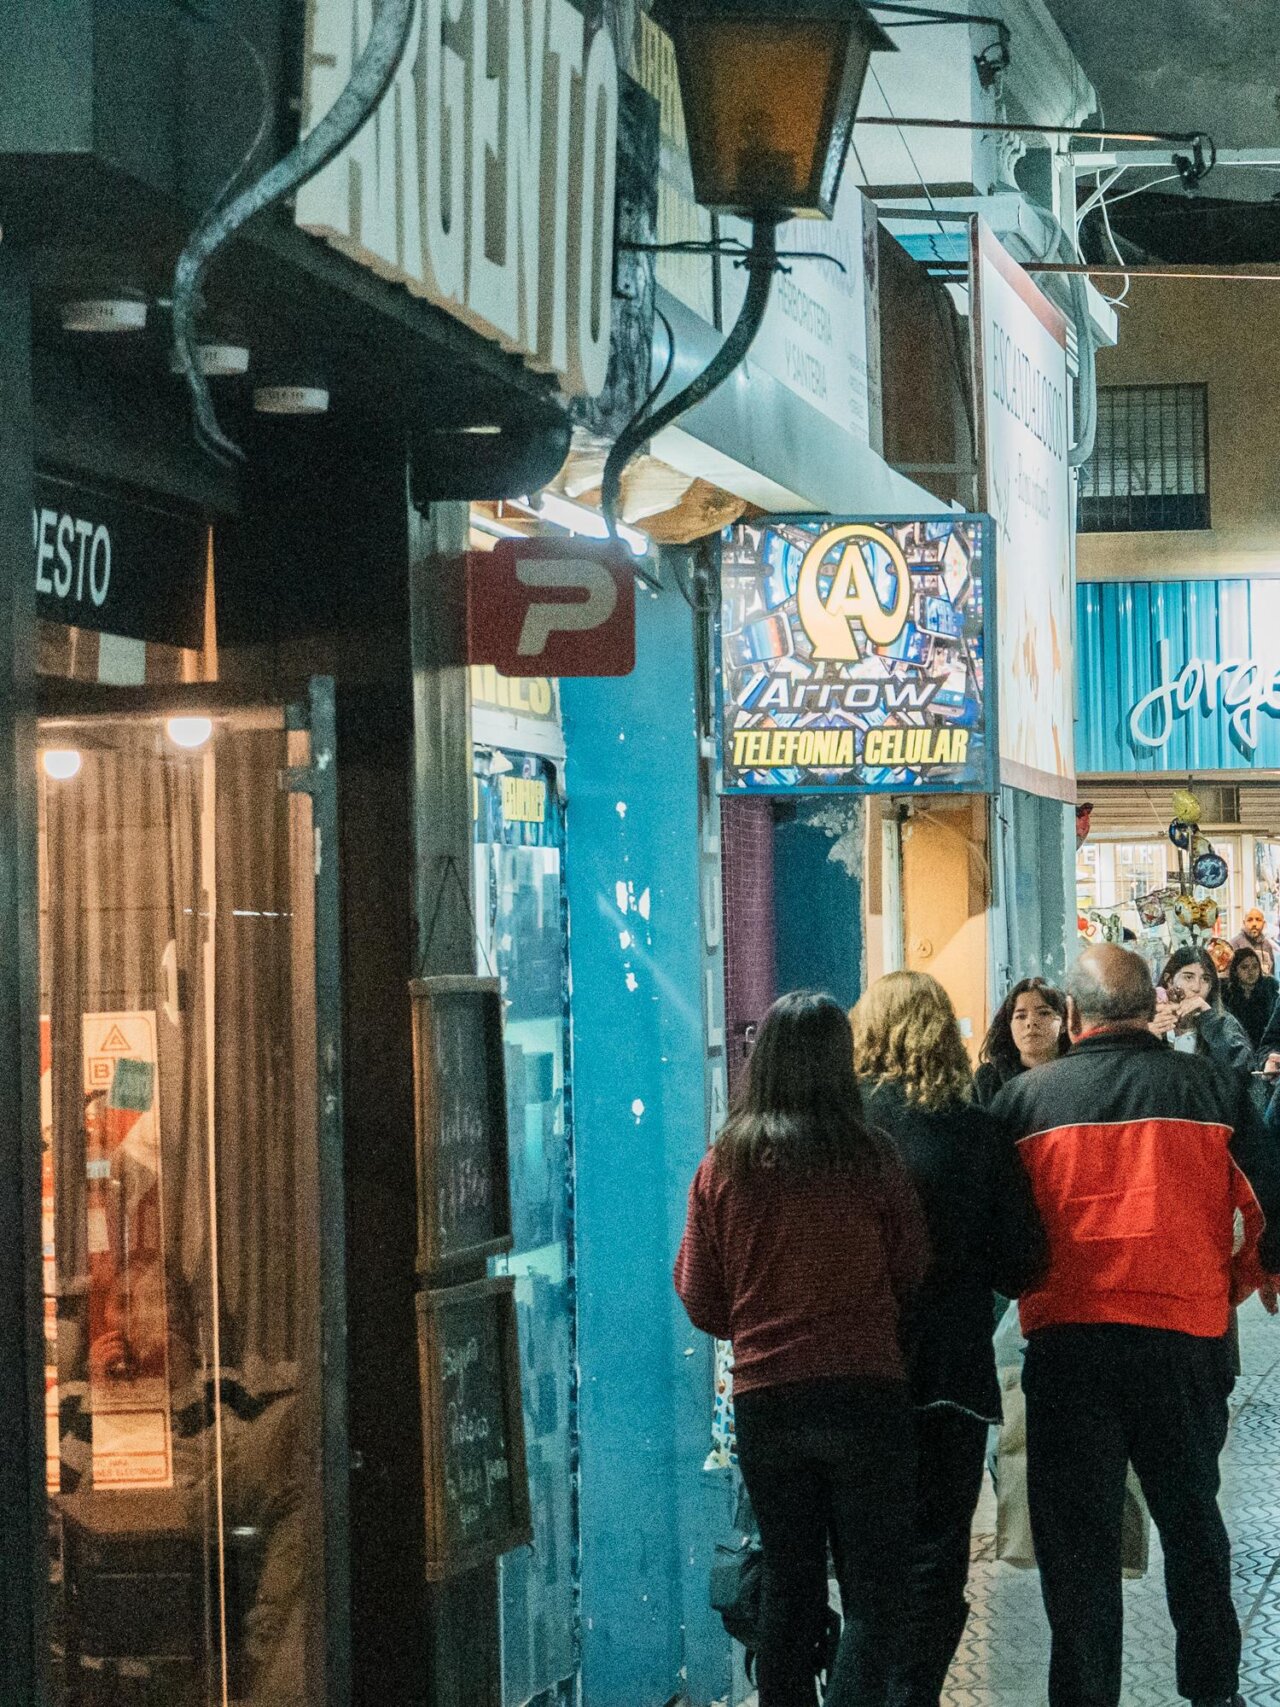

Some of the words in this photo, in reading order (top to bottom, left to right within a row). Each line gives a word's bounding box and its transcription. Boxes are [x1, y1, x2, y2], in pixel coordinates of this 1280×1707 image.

[992, 320, 1064, 462] ESCANDALOSOS
[33, 506, 112, 607] ESTO
[757, 676, 938, 710] Arrow
[733, 730, 854, 767] TELEFONIA
[864, 728, 969, 765] CELULAR
